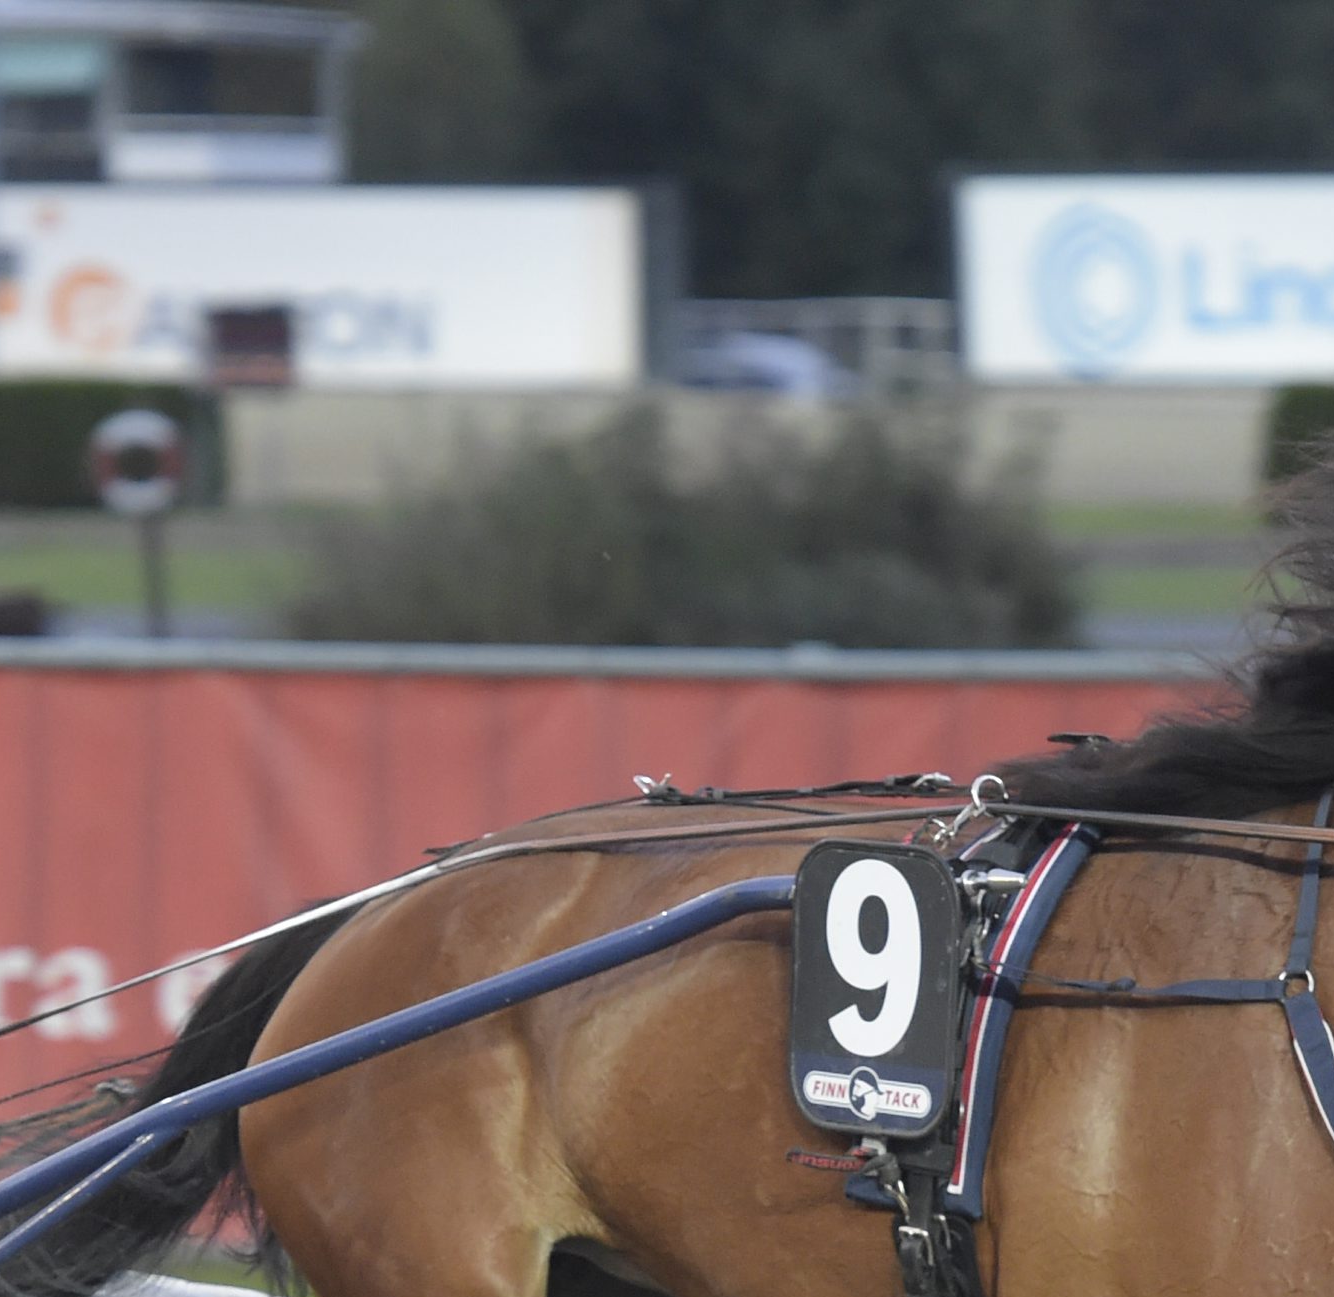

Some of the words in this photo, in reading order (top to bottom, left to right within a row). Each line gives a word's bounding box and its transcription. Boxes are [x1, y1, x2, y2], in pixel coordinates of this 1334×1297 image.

[825, 858, 923, 1058] 9
[812, 1080, 847, 1099] FINN
[884, 1089, 921, 1109] TACK
